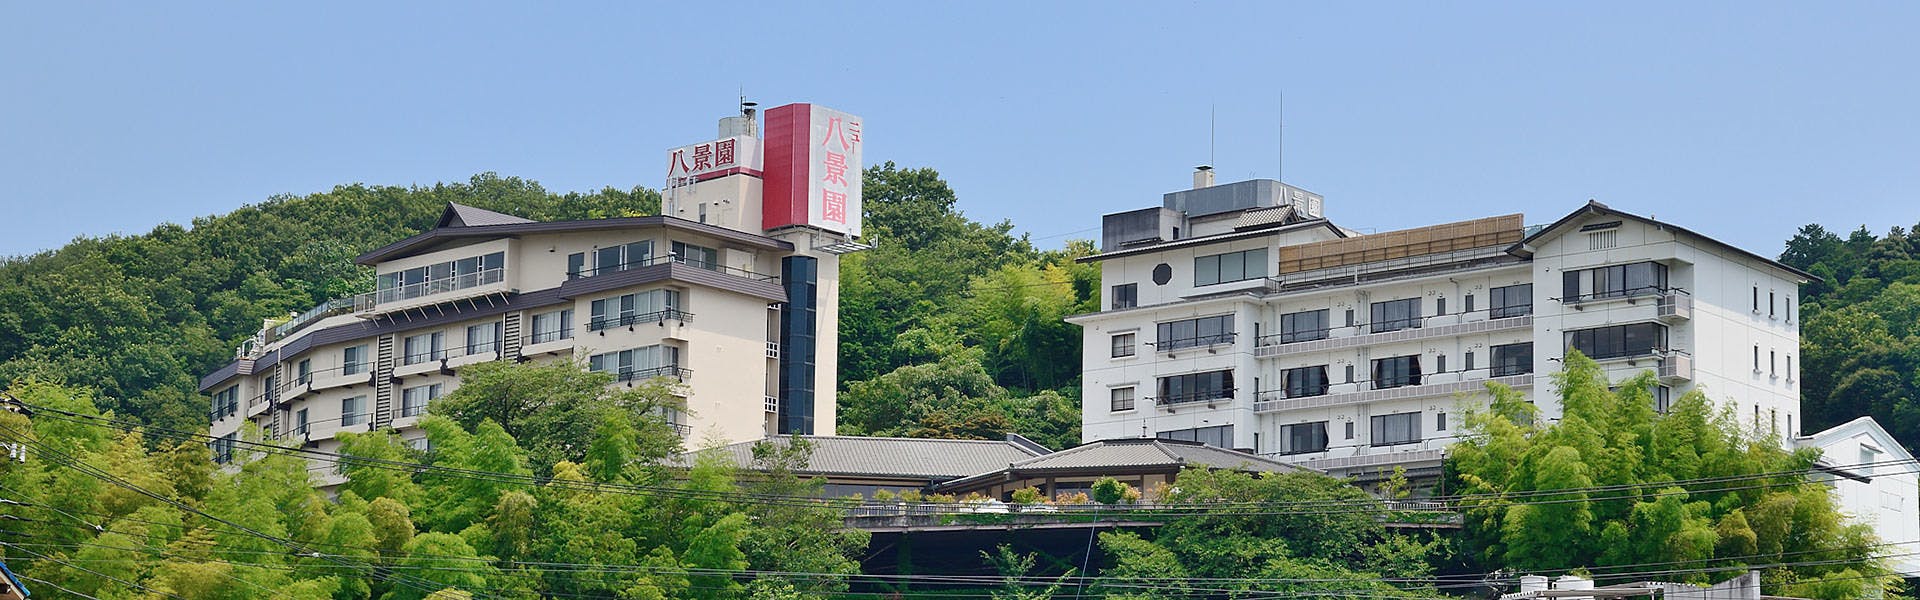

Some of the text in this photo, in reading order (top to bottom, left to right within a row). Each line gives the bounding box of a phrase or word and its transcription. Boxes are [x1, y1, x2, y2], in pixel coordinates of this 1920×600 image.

[667, 138, 736, 178] 八景園
[822, 117, 850, 225] 八景園
